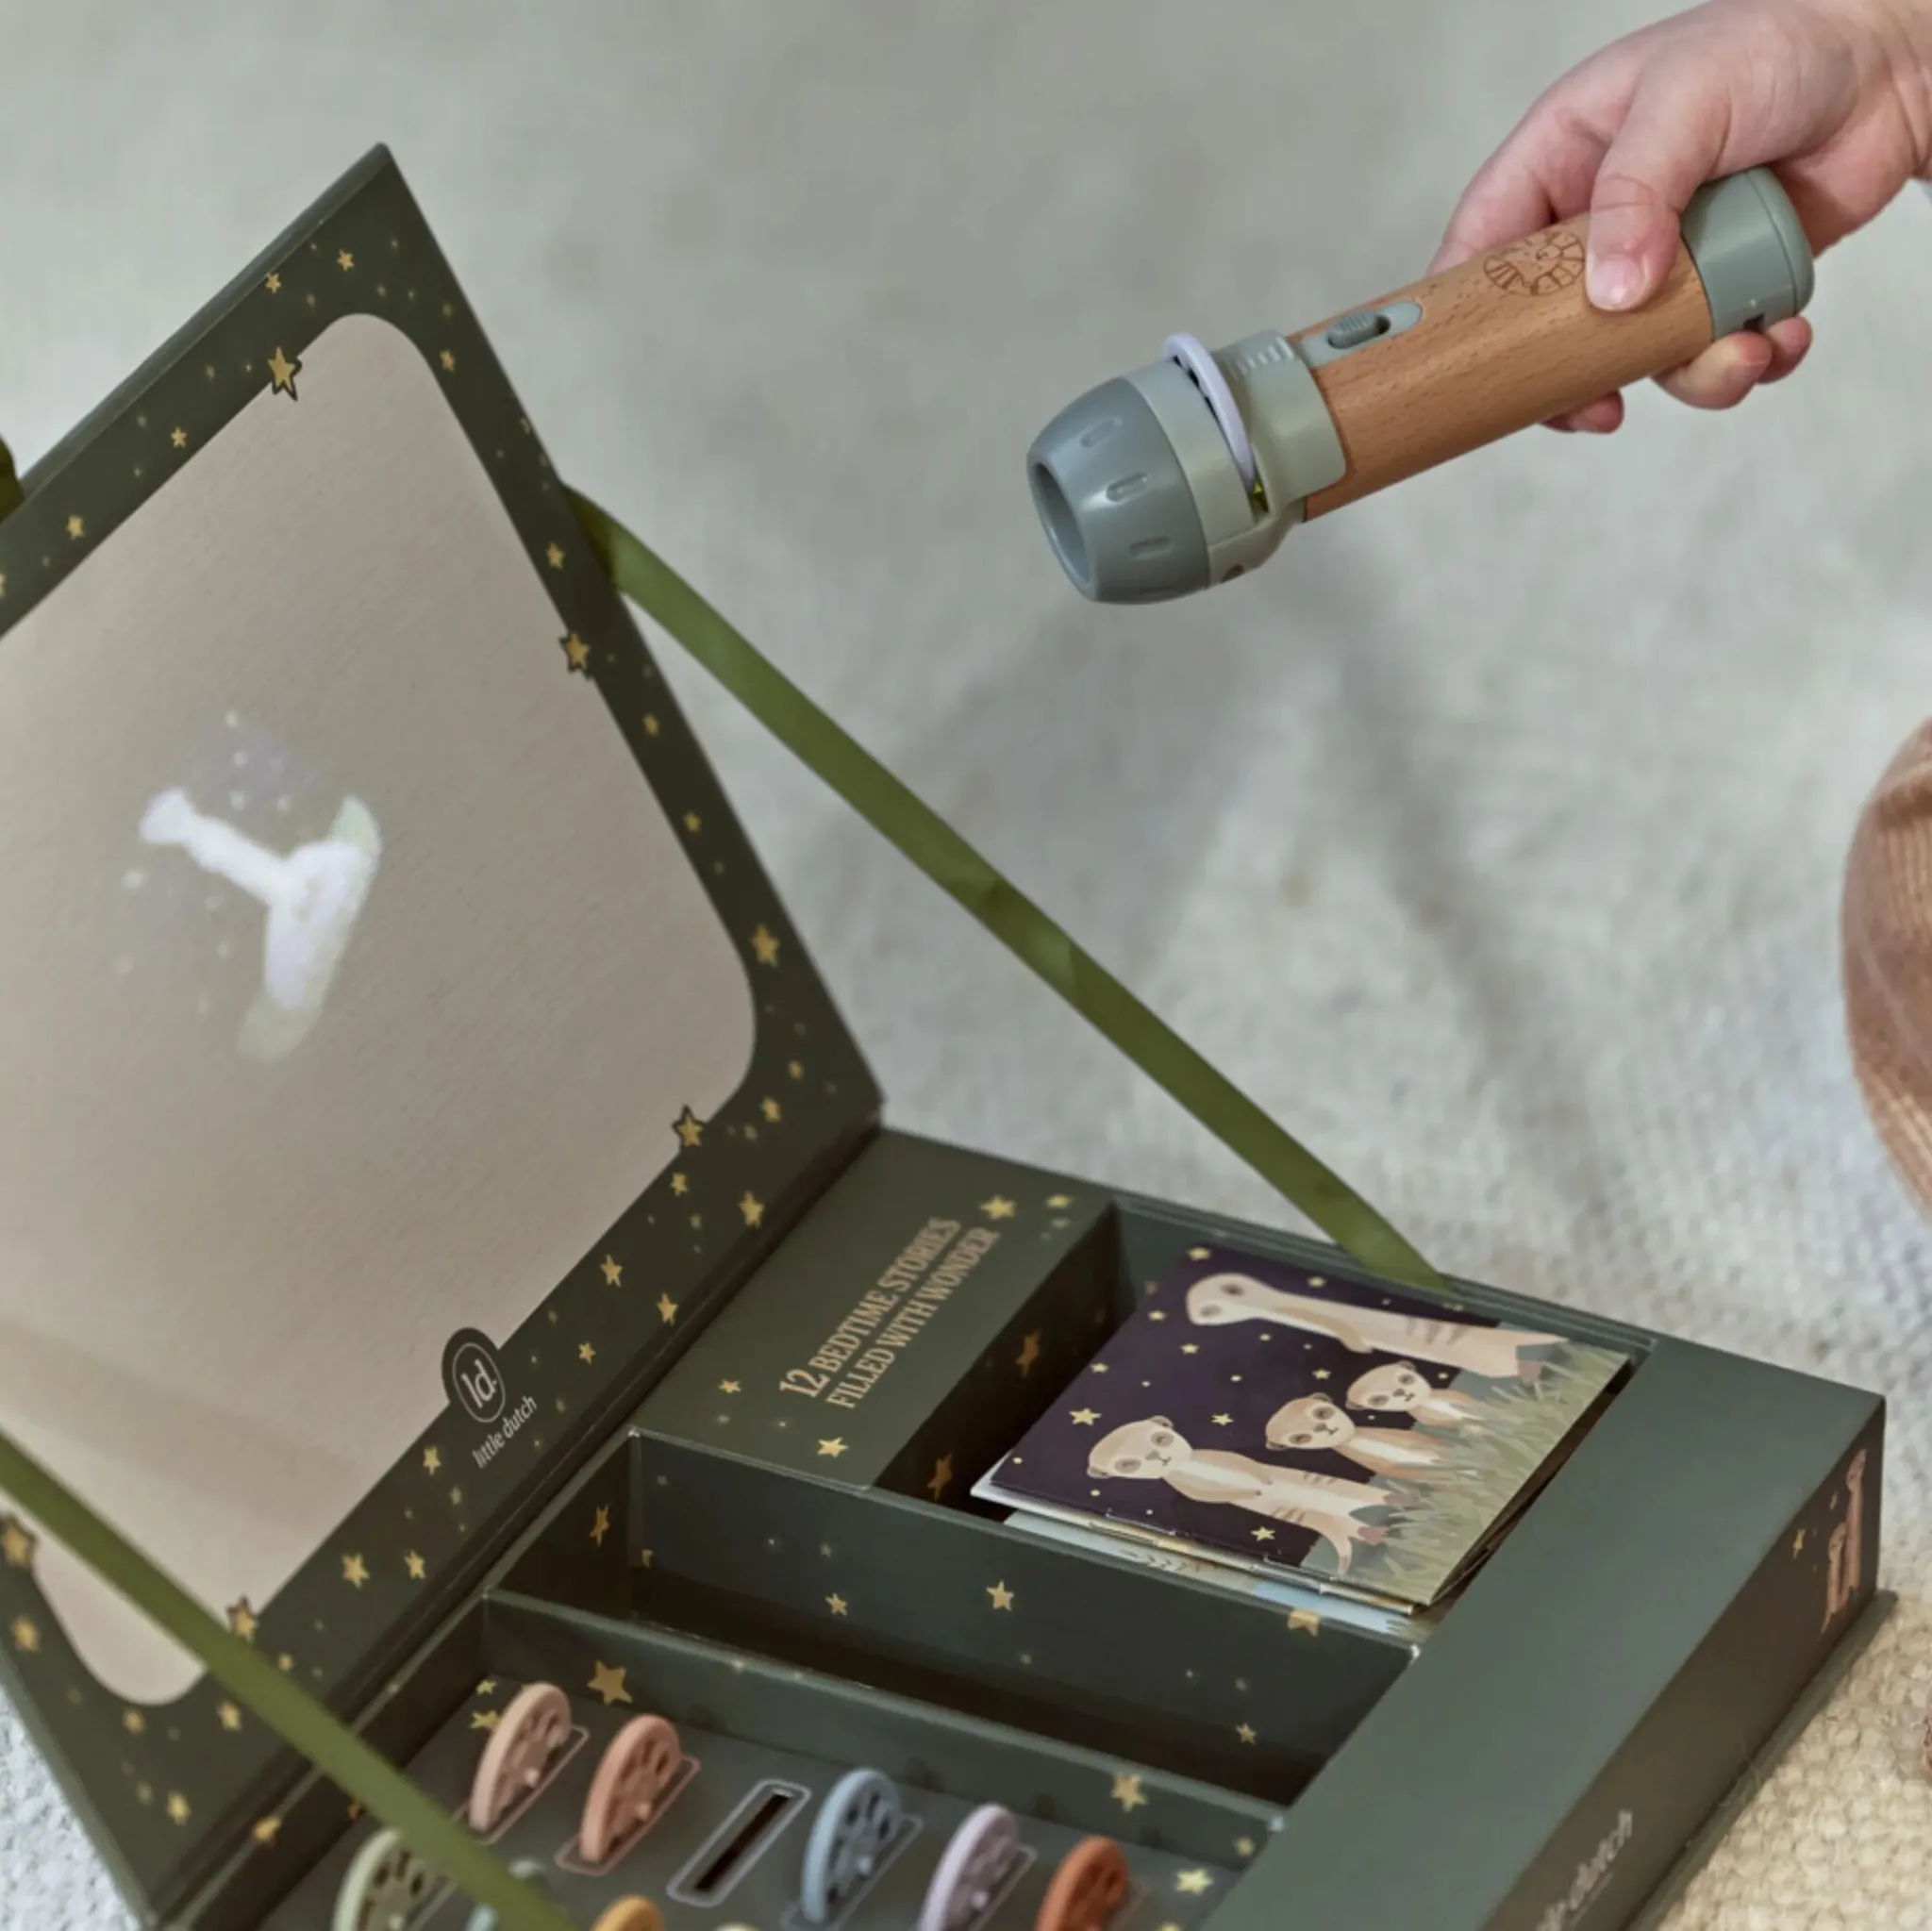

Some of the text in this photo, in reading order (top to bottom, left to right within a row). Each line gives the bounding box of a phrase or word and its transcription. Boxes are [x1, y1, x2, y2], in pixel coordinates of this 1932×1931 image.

[779, 1216, 962, 1397] 12 BEDTIME STORIES
[825, 1227, 1001, 1408] FILLED WITH WONDER
[473, 1395, 538, 1469] little dutch
